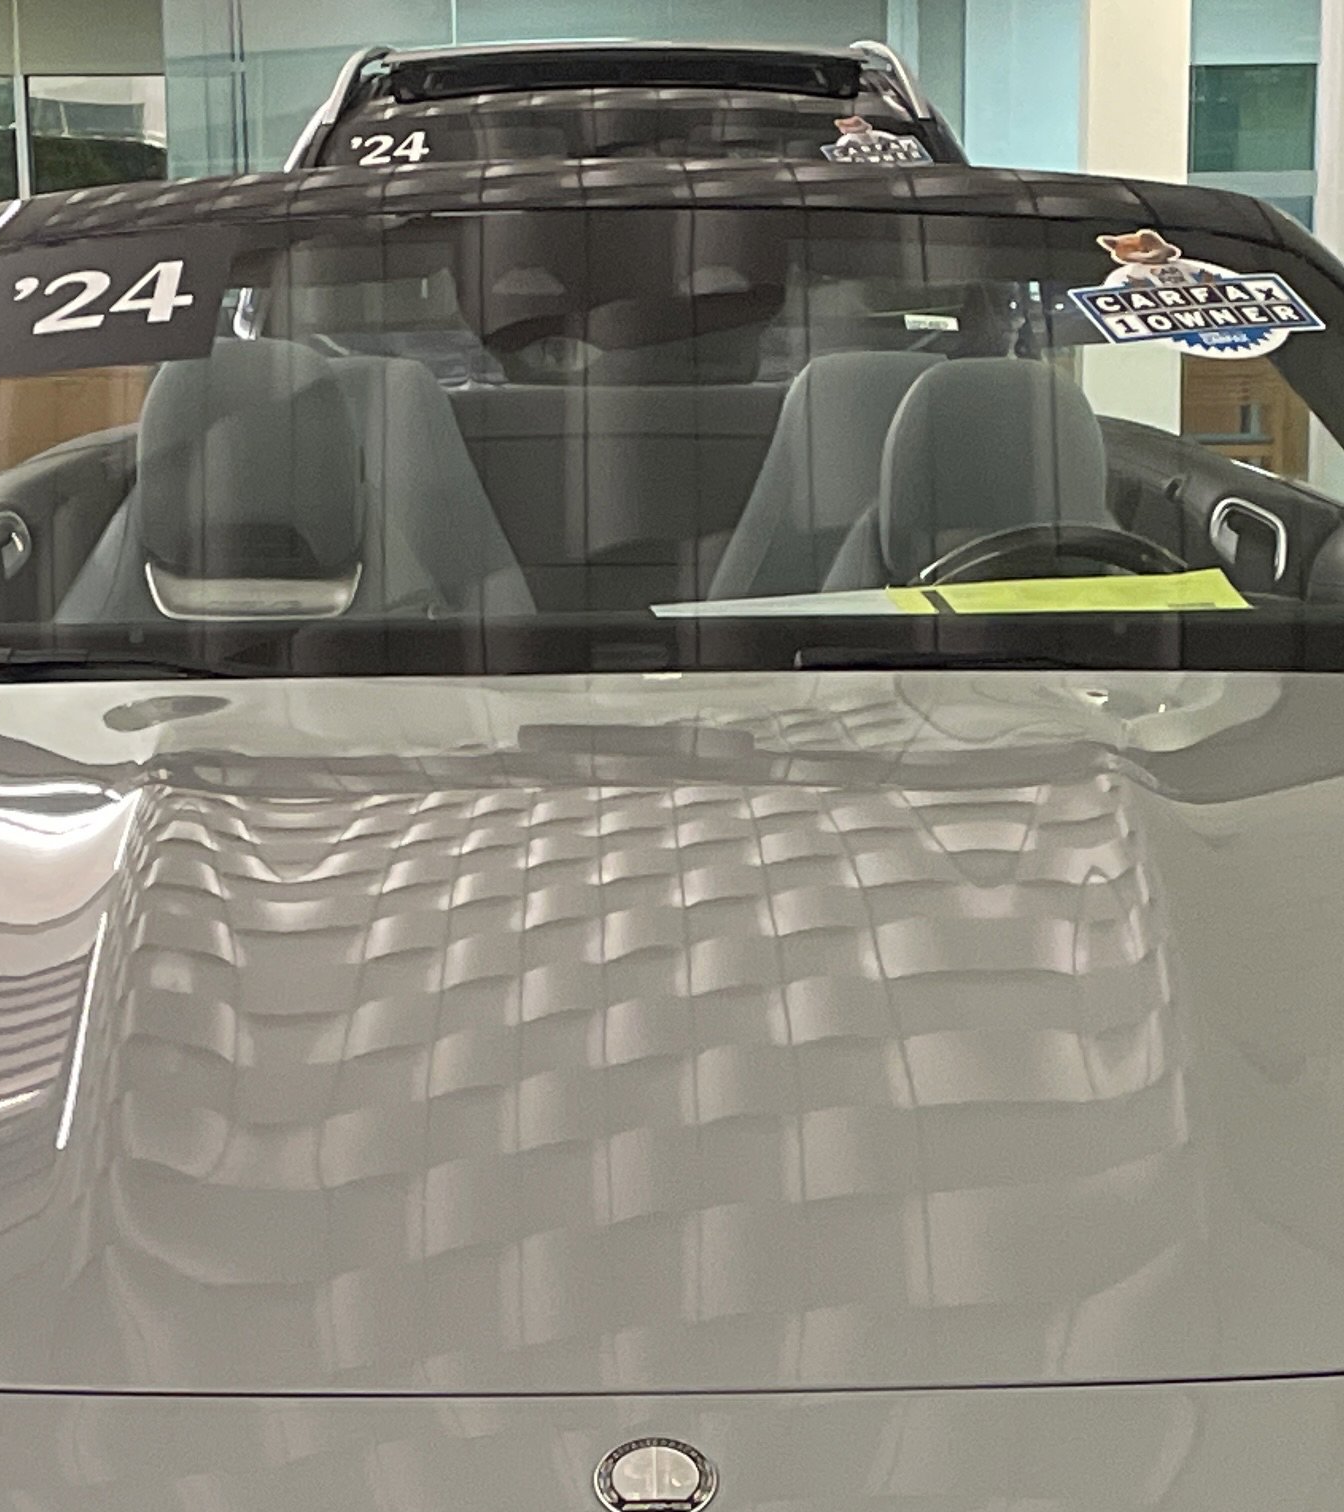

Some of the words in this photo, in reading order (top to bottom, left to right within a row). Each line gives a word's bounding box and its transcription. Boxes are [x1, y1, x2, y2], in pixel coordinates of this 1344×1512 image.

[1096, 283, 1281, 314] CARFAX
[1115, 317, 1139, 334] 1
[1147, 303, 1300, 331] OWNER
